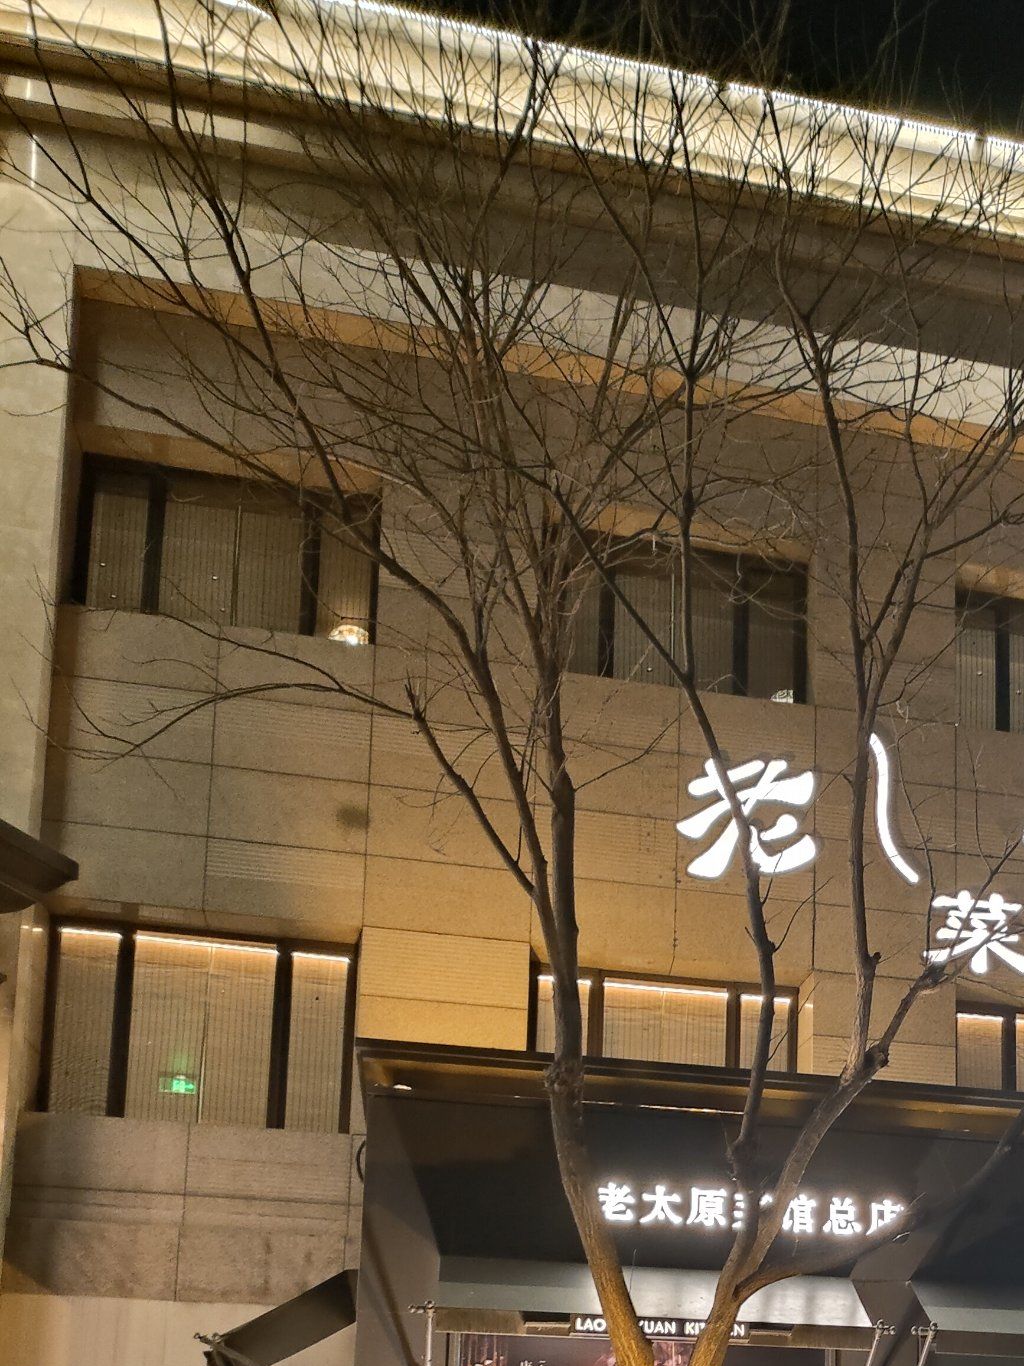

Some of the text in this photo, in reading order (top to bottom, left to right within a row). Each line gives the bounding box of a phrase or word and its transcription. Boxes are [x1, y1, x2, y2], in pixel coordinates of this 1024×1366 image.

[598, 1182, 906, 1236] 老太原馆总店
[575, 1317, 606, 1332] LAO
[638, 1319, 676, 1335] UAN
